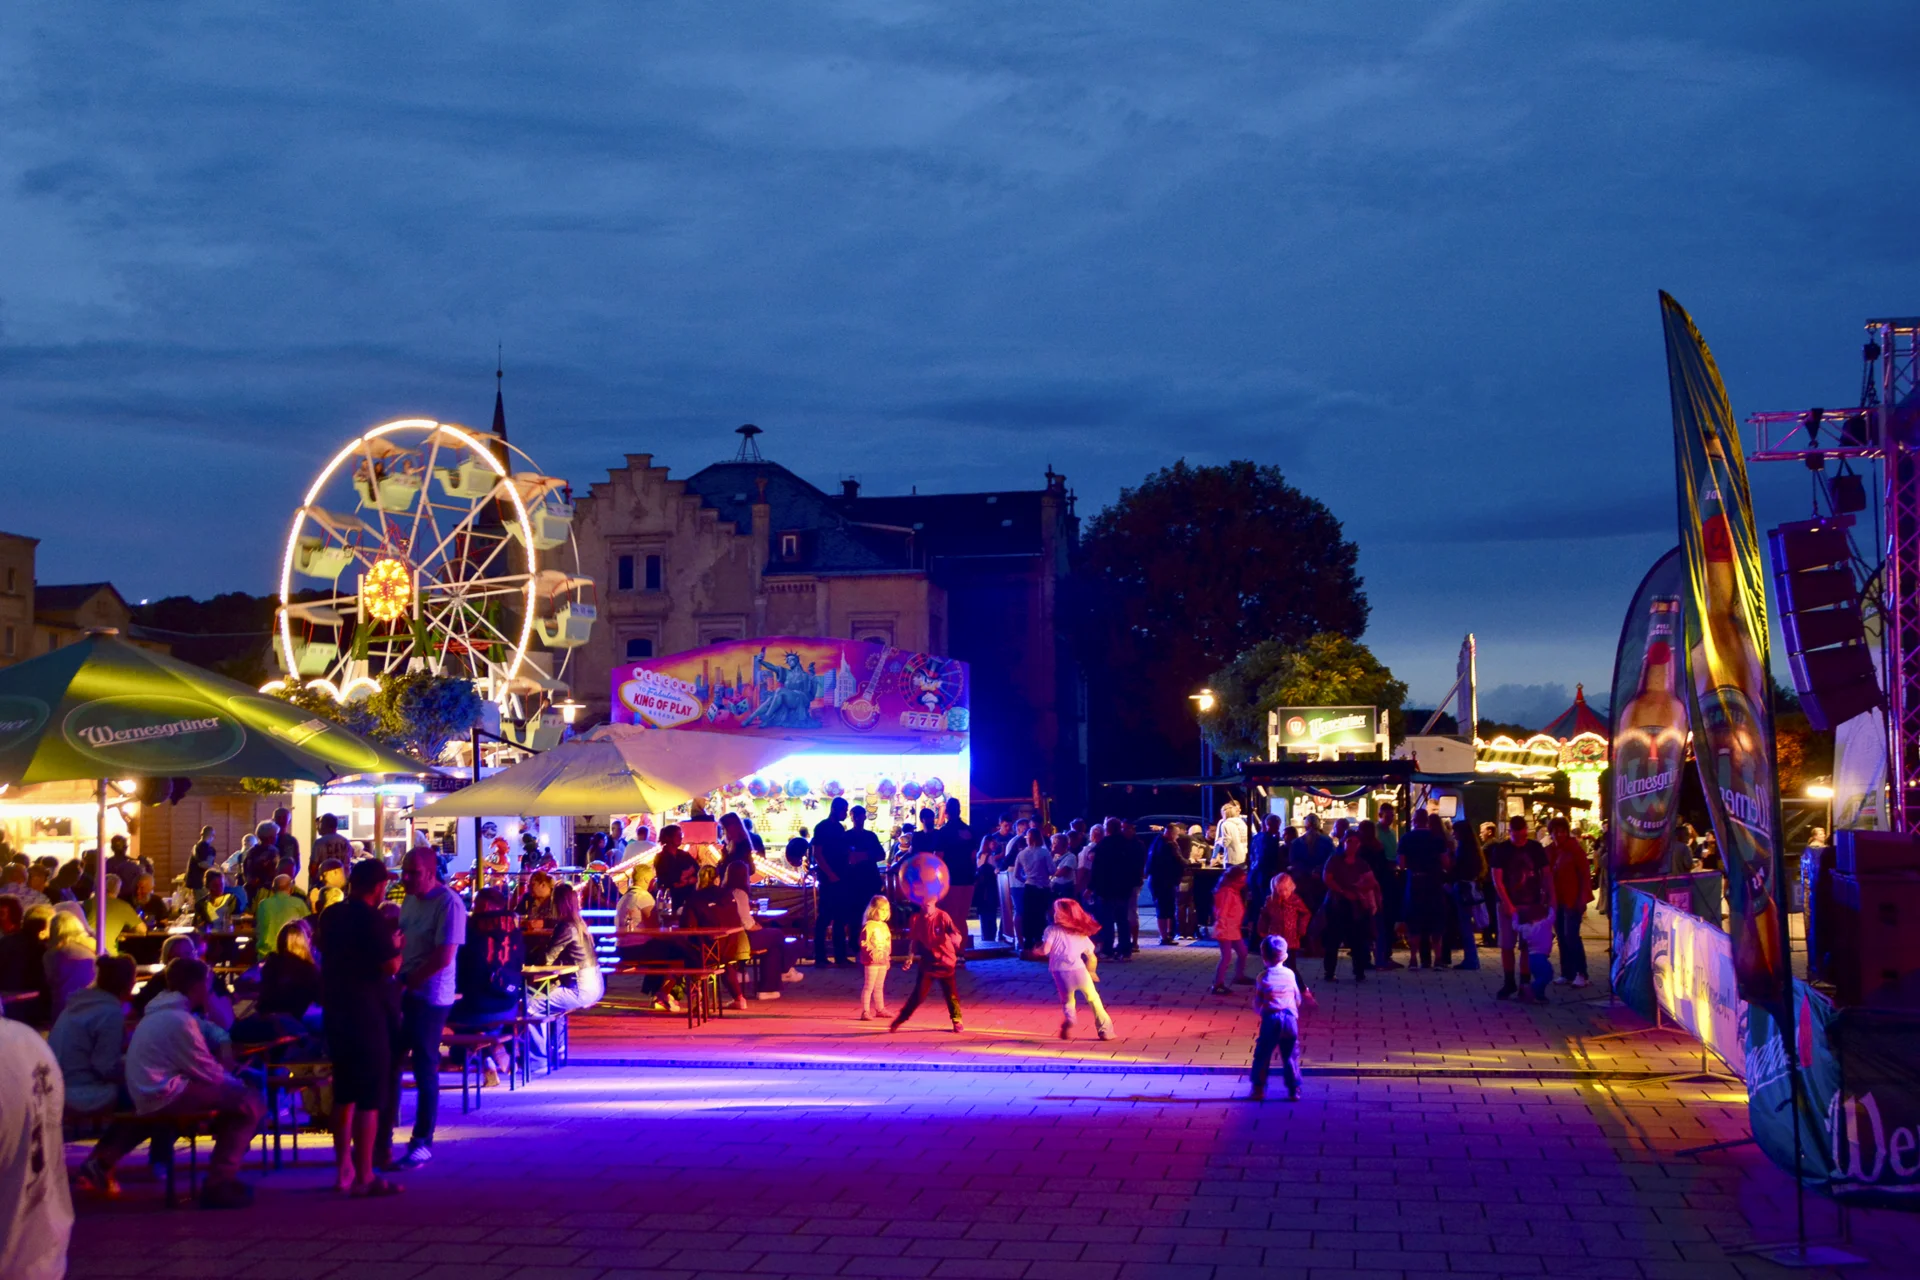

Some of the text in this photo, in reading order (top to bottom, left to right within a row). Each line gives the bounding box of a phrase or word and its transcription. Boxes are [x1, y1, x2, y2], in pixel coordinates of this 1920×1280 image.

[633, 692, 693, 717] KING OF PLAY
[78, 716, 220, 746] Wernesgrüner
